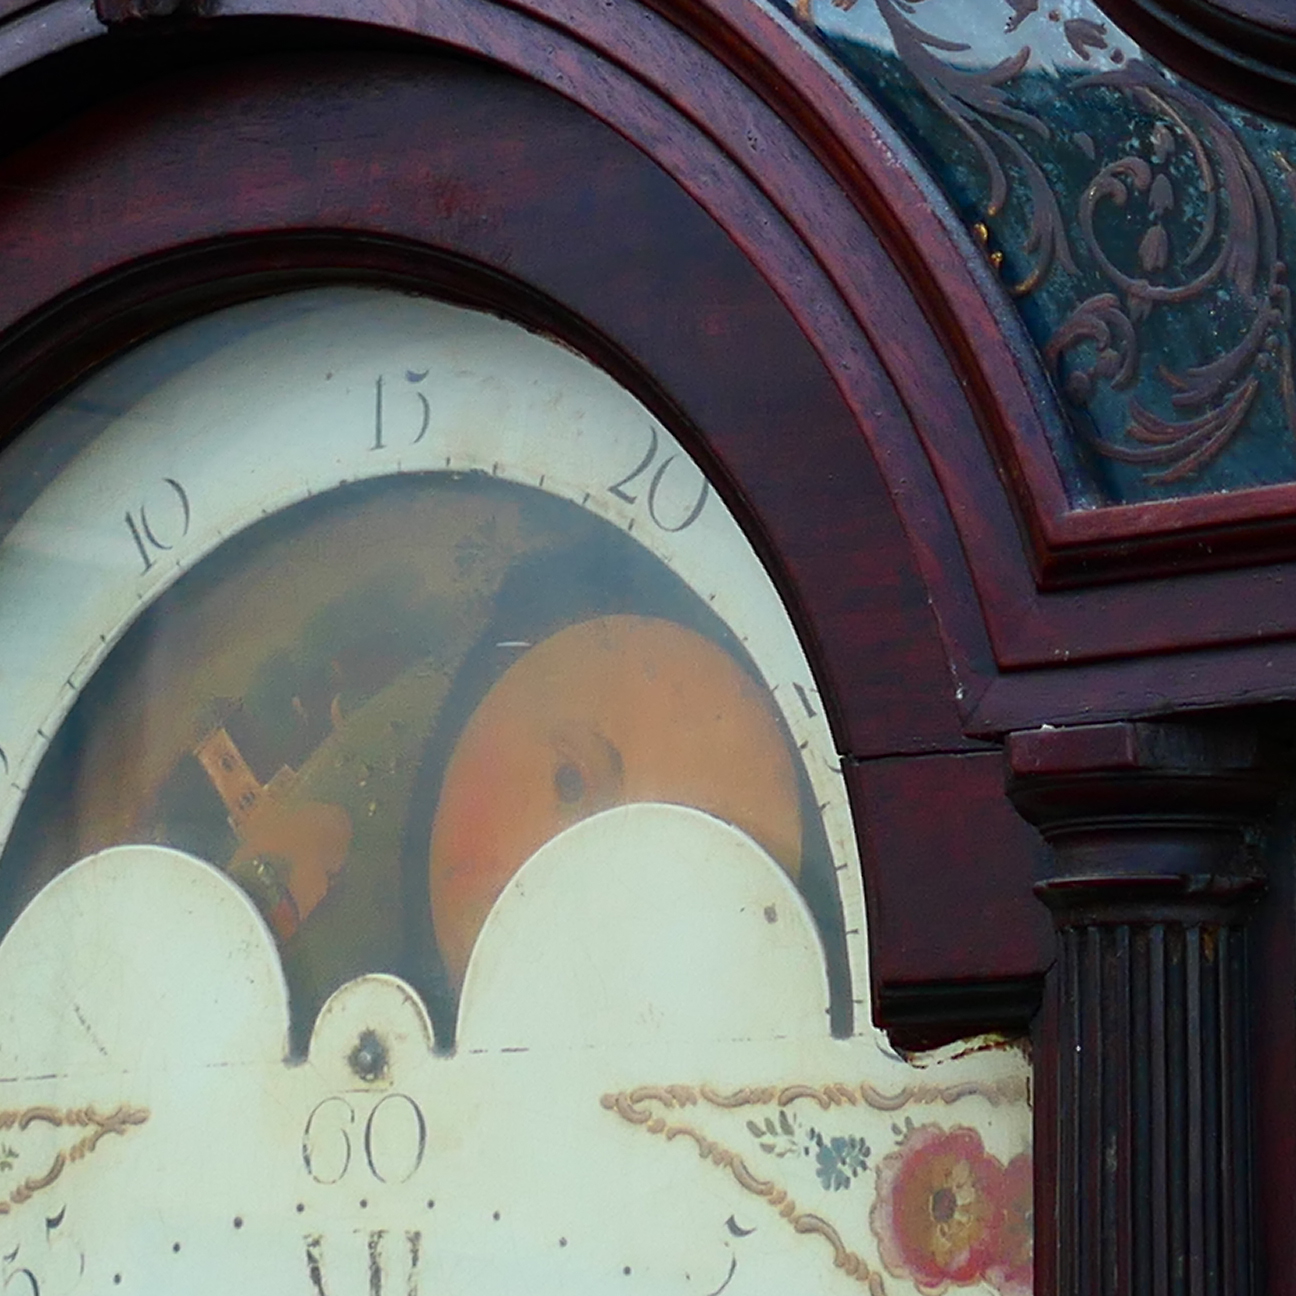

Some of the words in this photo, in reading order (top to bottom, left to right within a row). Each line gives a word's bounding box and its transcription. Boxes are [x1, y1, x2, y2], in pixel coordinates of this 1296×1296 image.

[368, 365, 433, 452] 15
[124, 476, 191, 576] 10
[606, 423, 710, 533] 20
[302, 1093, 427, 1185] 60
